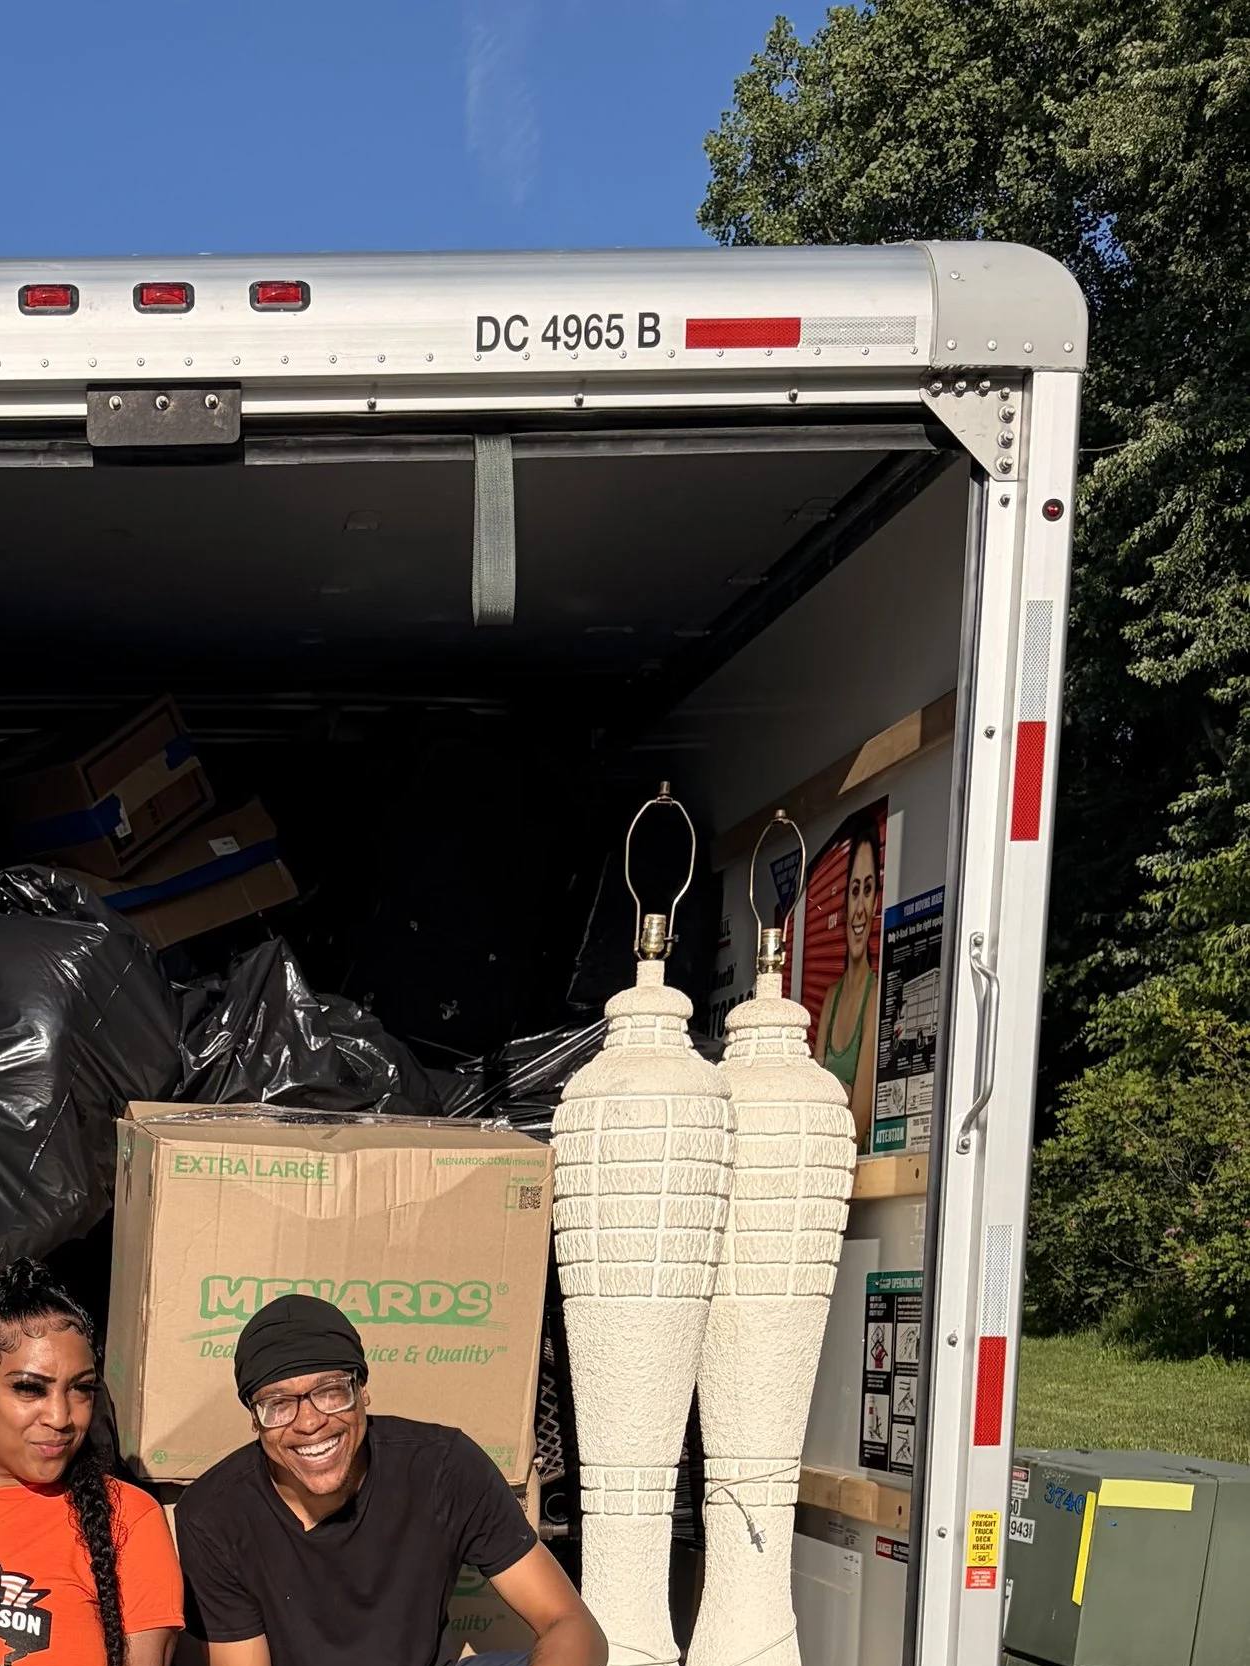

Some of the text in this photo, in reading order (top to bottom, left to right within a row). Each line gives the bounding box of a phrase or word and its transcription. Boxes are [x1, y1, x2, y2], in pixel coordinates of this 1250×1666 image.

[475, 312, 661, 352] DC 4965 B
[875, 1127, 905, 1144] ATTENTION
[174, 1155, 330, 1180] EXTRA LARGE
[404, 1344, 421, 1363] &
[426, 1343, 494, 1364] Quality
[1044, 1482, 1086, 1515] 3740
[972, 1520, 997, 1528] FREIGHT
[972, 1543, 994, 1551] HEIGHT
